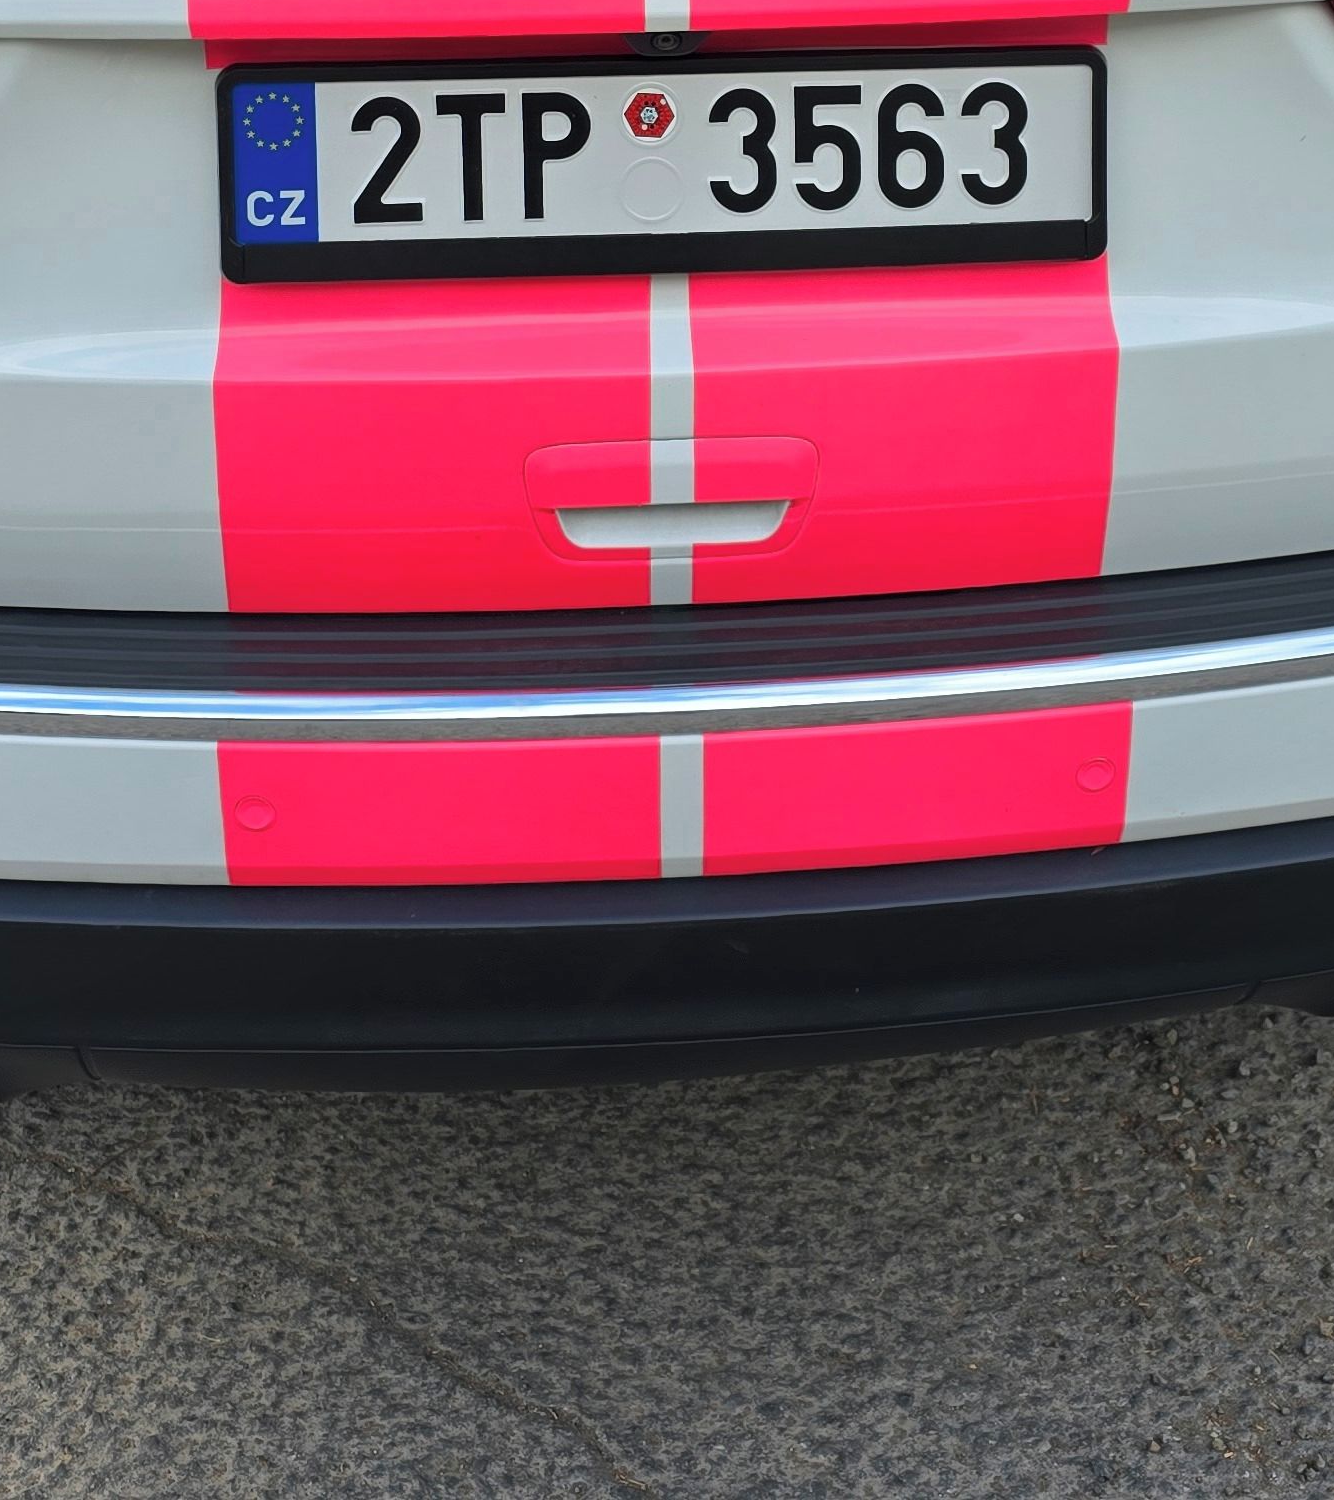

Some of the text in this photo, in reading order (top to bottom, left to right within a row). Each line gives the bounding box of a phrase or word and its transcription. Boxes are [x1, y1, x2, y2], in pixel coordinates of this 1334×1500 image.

[350, 80, 1029, 224] 2TP 3563
[245, 190, 307, 226] CZ
